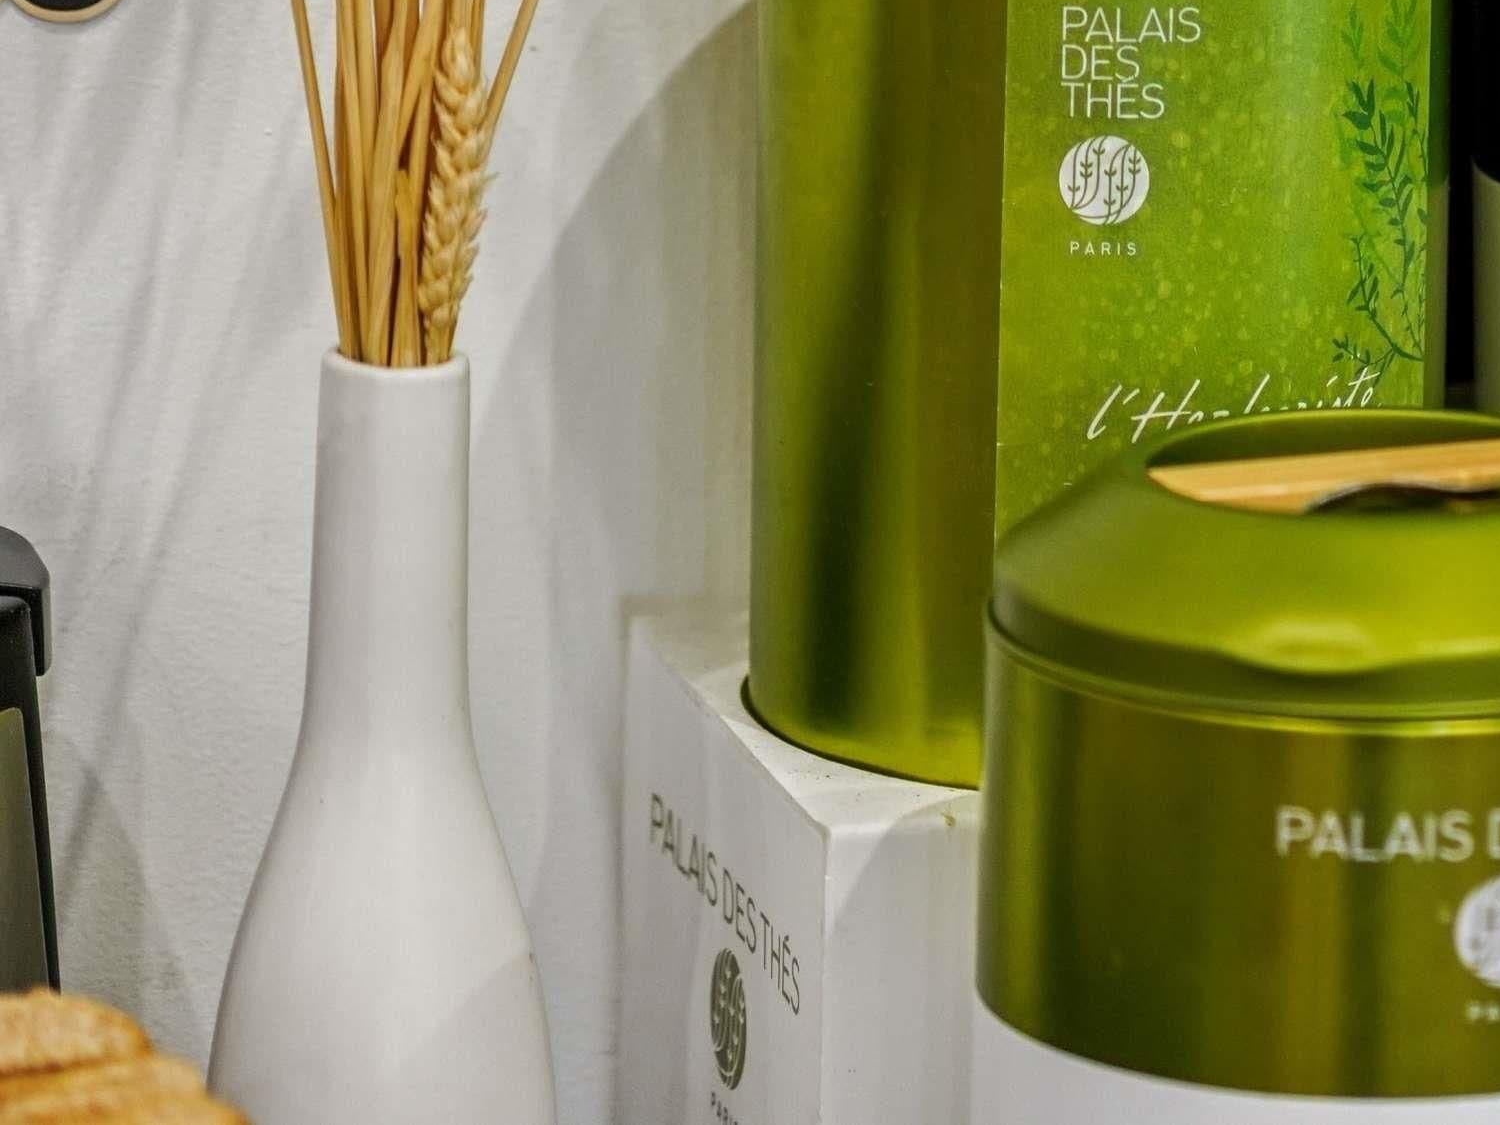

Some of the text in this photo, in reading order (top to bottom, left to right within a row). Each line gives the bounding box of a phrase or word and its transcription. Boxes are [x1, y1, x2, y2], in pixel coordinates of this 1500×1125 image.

[1061, 6, 1202, 43] PALAIS
[1061, 44, 1140, 82] DES
[1060, 74, 1166, 120] THÉS
[1069, 241, 1138, 257] PARIS
[1275, 805, 1476, 864] PALAIS
[650, 792, 800, 1016] PALAIS DES THÉS
